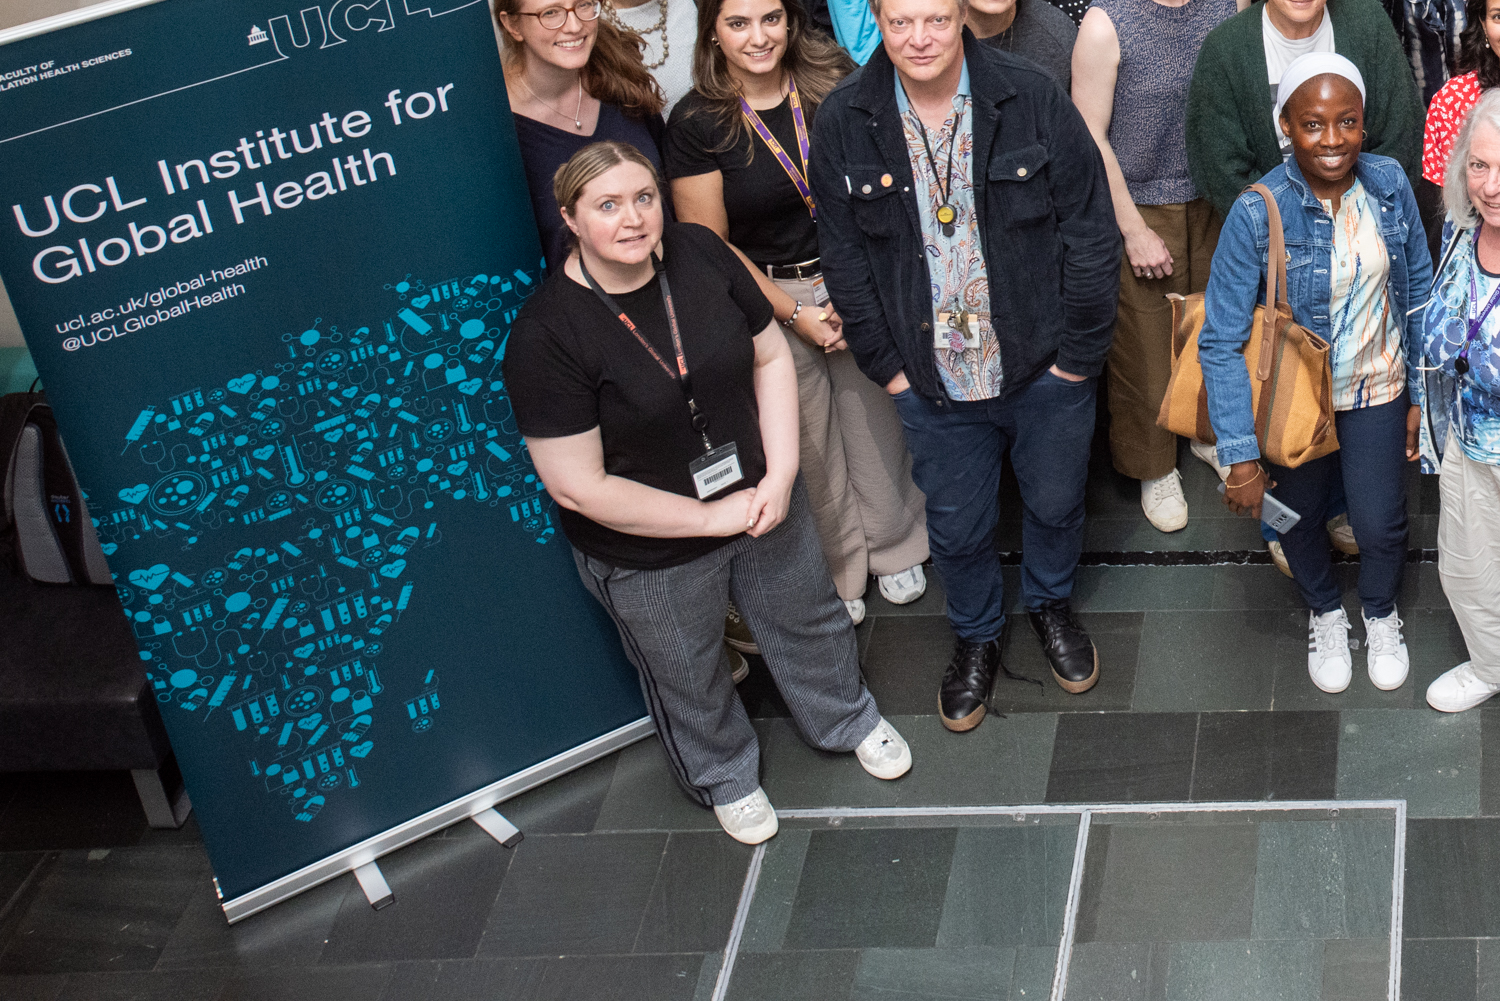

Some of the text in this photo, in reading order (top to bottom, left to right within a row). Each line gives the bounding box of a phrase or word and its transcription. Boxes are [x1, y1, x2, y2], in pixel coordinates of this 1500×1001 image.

[0, 48, 133, 92] LATION HEALTH SCIENCES
[40, 60, 55, 70] OF
[12, 82, 455, 238] UCL Institute for
[32, 148, 398, 284] Global Health
[55, 254, 269, 335] ucl.ac.uk/global-health
[62, 282, 246, 352] @UCLGlobalHealth
[666, 294, 674, 318] University
[1477, 303, 1490, 322] University
[1489, 290, 1498, 302] Global
[623, 319, 675, 378] UCL London's Global University
